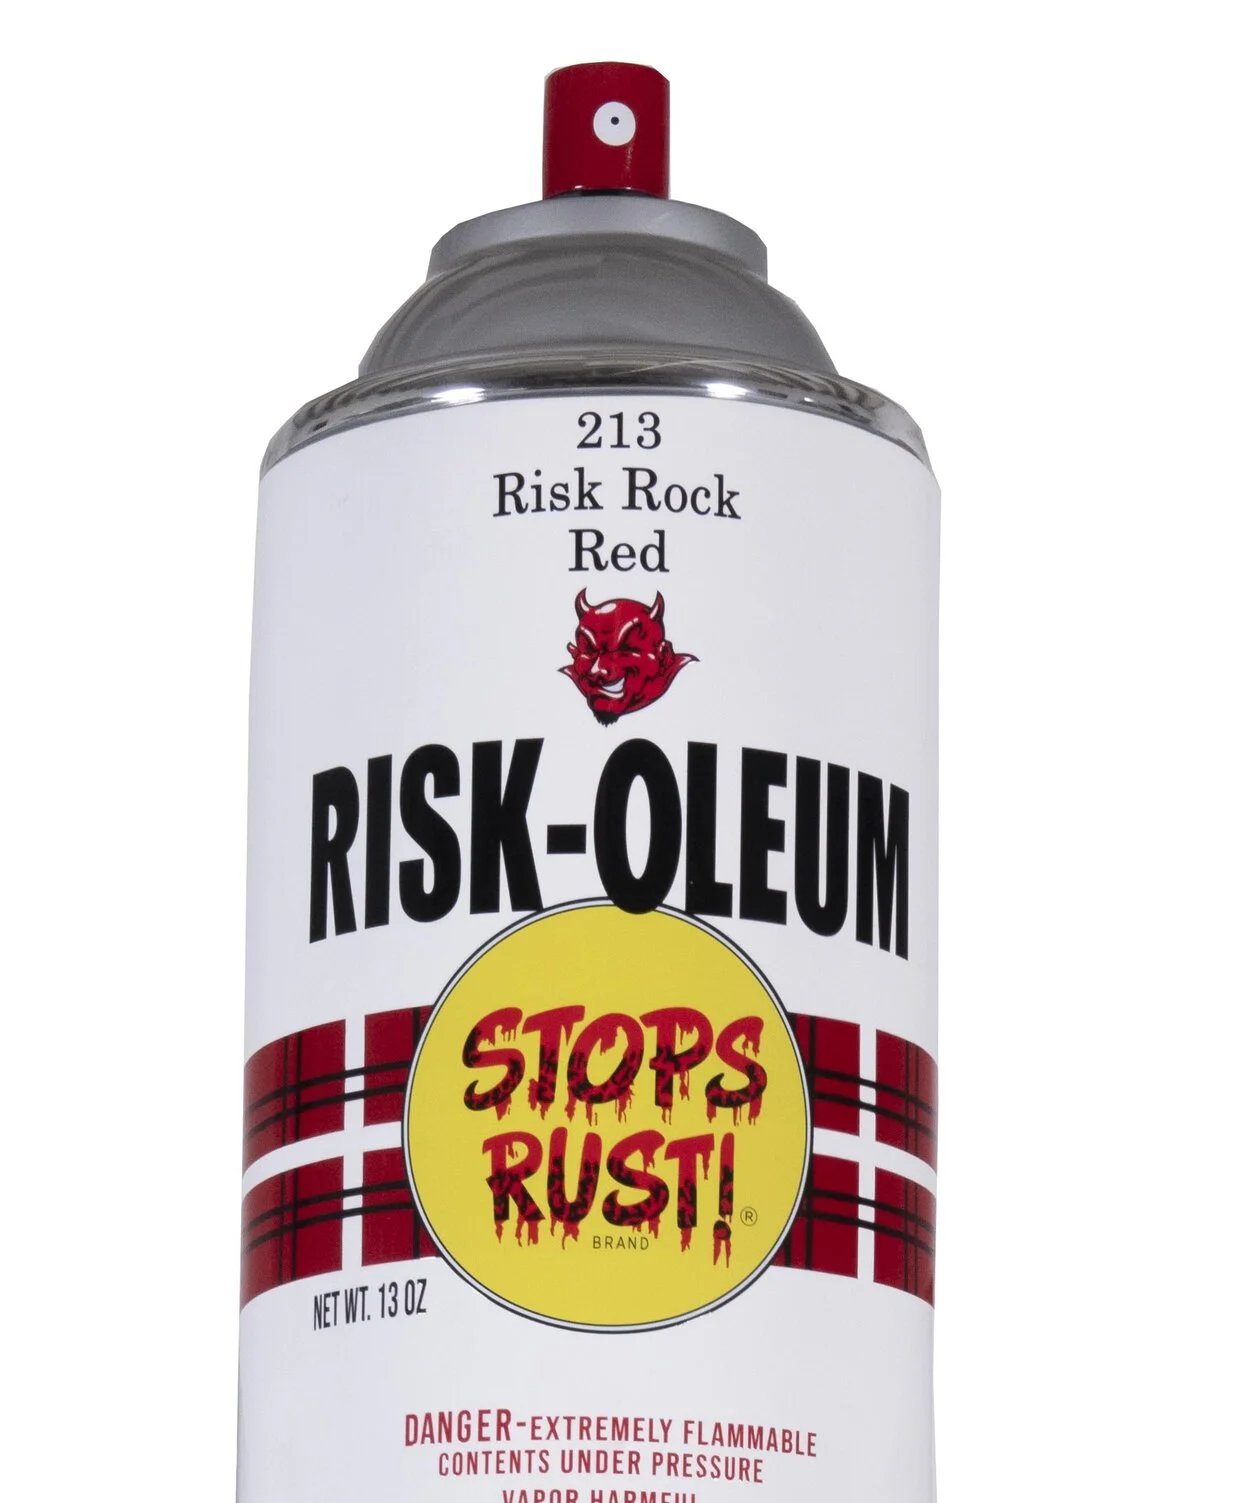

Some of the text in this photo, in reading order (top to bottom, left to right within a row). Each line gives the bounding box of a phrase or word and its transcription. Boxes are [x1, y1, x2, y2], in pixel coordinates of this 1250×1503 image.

[576, 411, 662, 450] 213
[492, 466, 742, 520] Risk Rock
[568, 528, 670, 573] Red
[309, 738, 910, 961] RISK-OLEUM
[462, 1005, 768, 1126] STOPS
[481, 1126, 735, 1268] RUST!
[592, 1235, 649, 1251] BRAND
[313, 1278, 428, 1331] NET WT. 13 OZ
[683, 1419, 817, 1457] FLAMMABLE
[438, 1449, 764, 1483] CONTENTS UNDER PRESSURE
